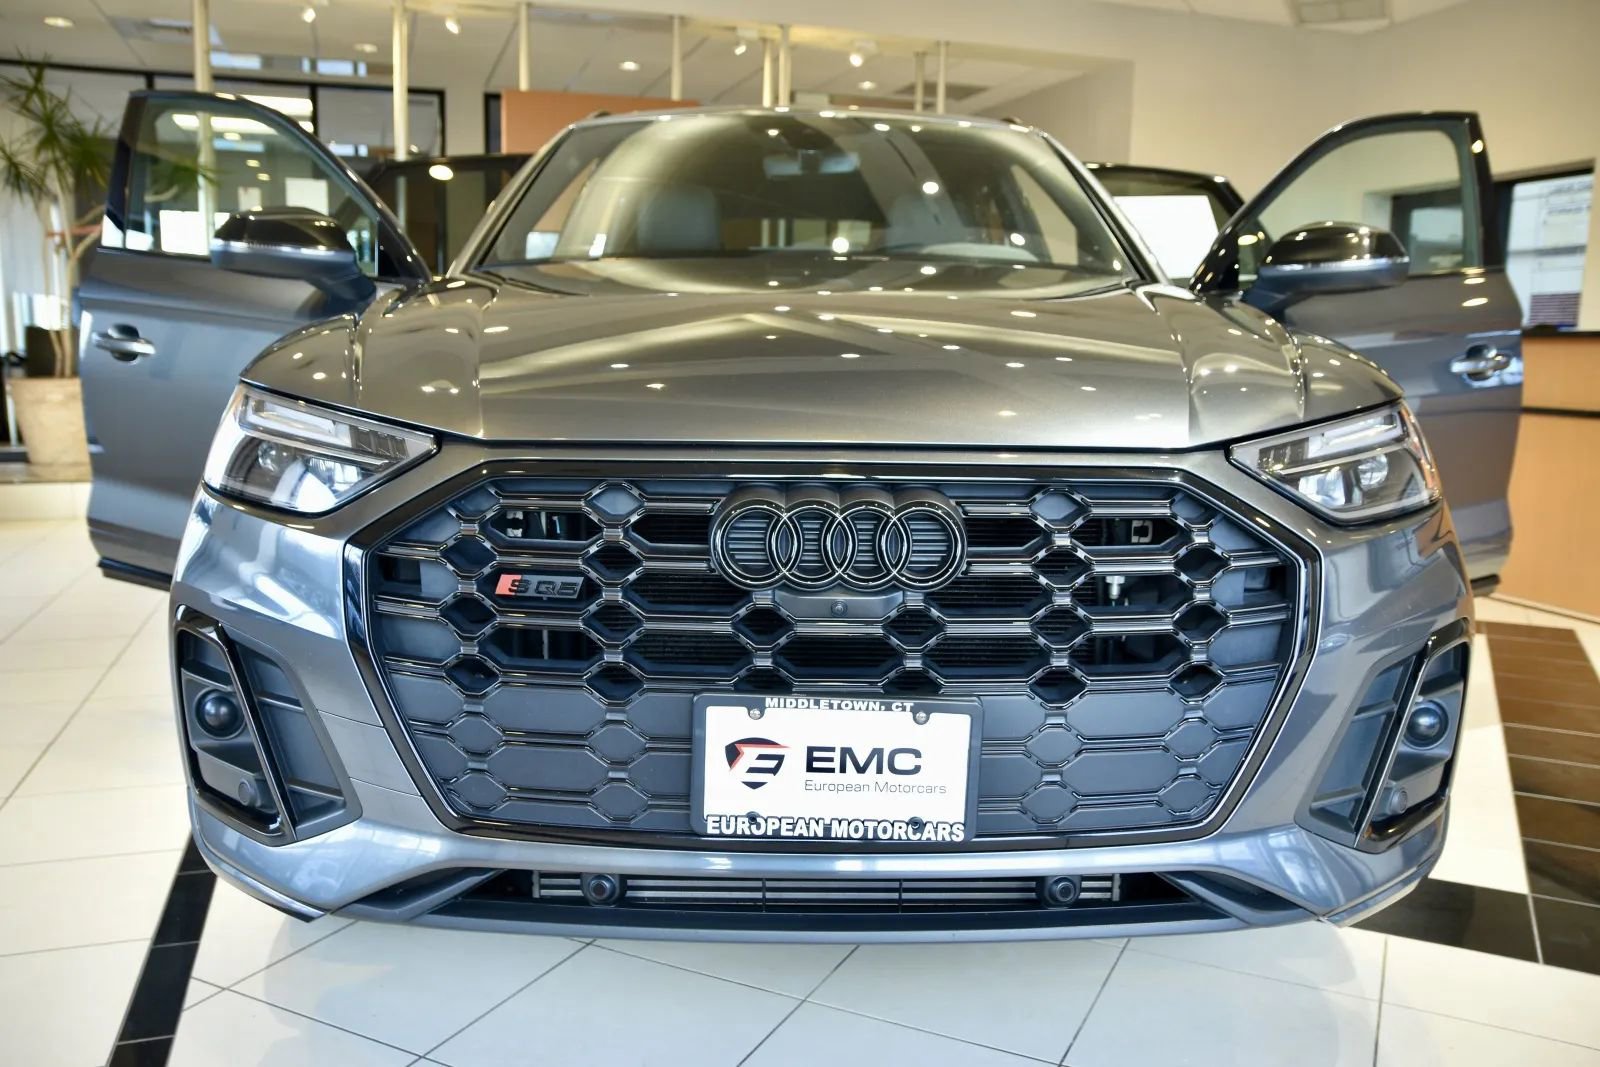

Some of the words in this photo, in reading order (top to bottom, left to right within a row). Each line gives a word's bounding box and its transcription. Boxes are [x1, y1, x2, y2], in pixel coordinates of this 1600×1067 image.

[508, 579, 578, 596] SQ5
[891, 702, 914, 712] CT
[805, 746, 922, 775] EMC
[804, 780, 870, 794] European
[874, 781, 947, 794] Motorcars
[706, 816, 825, 838] EUROPEAN
